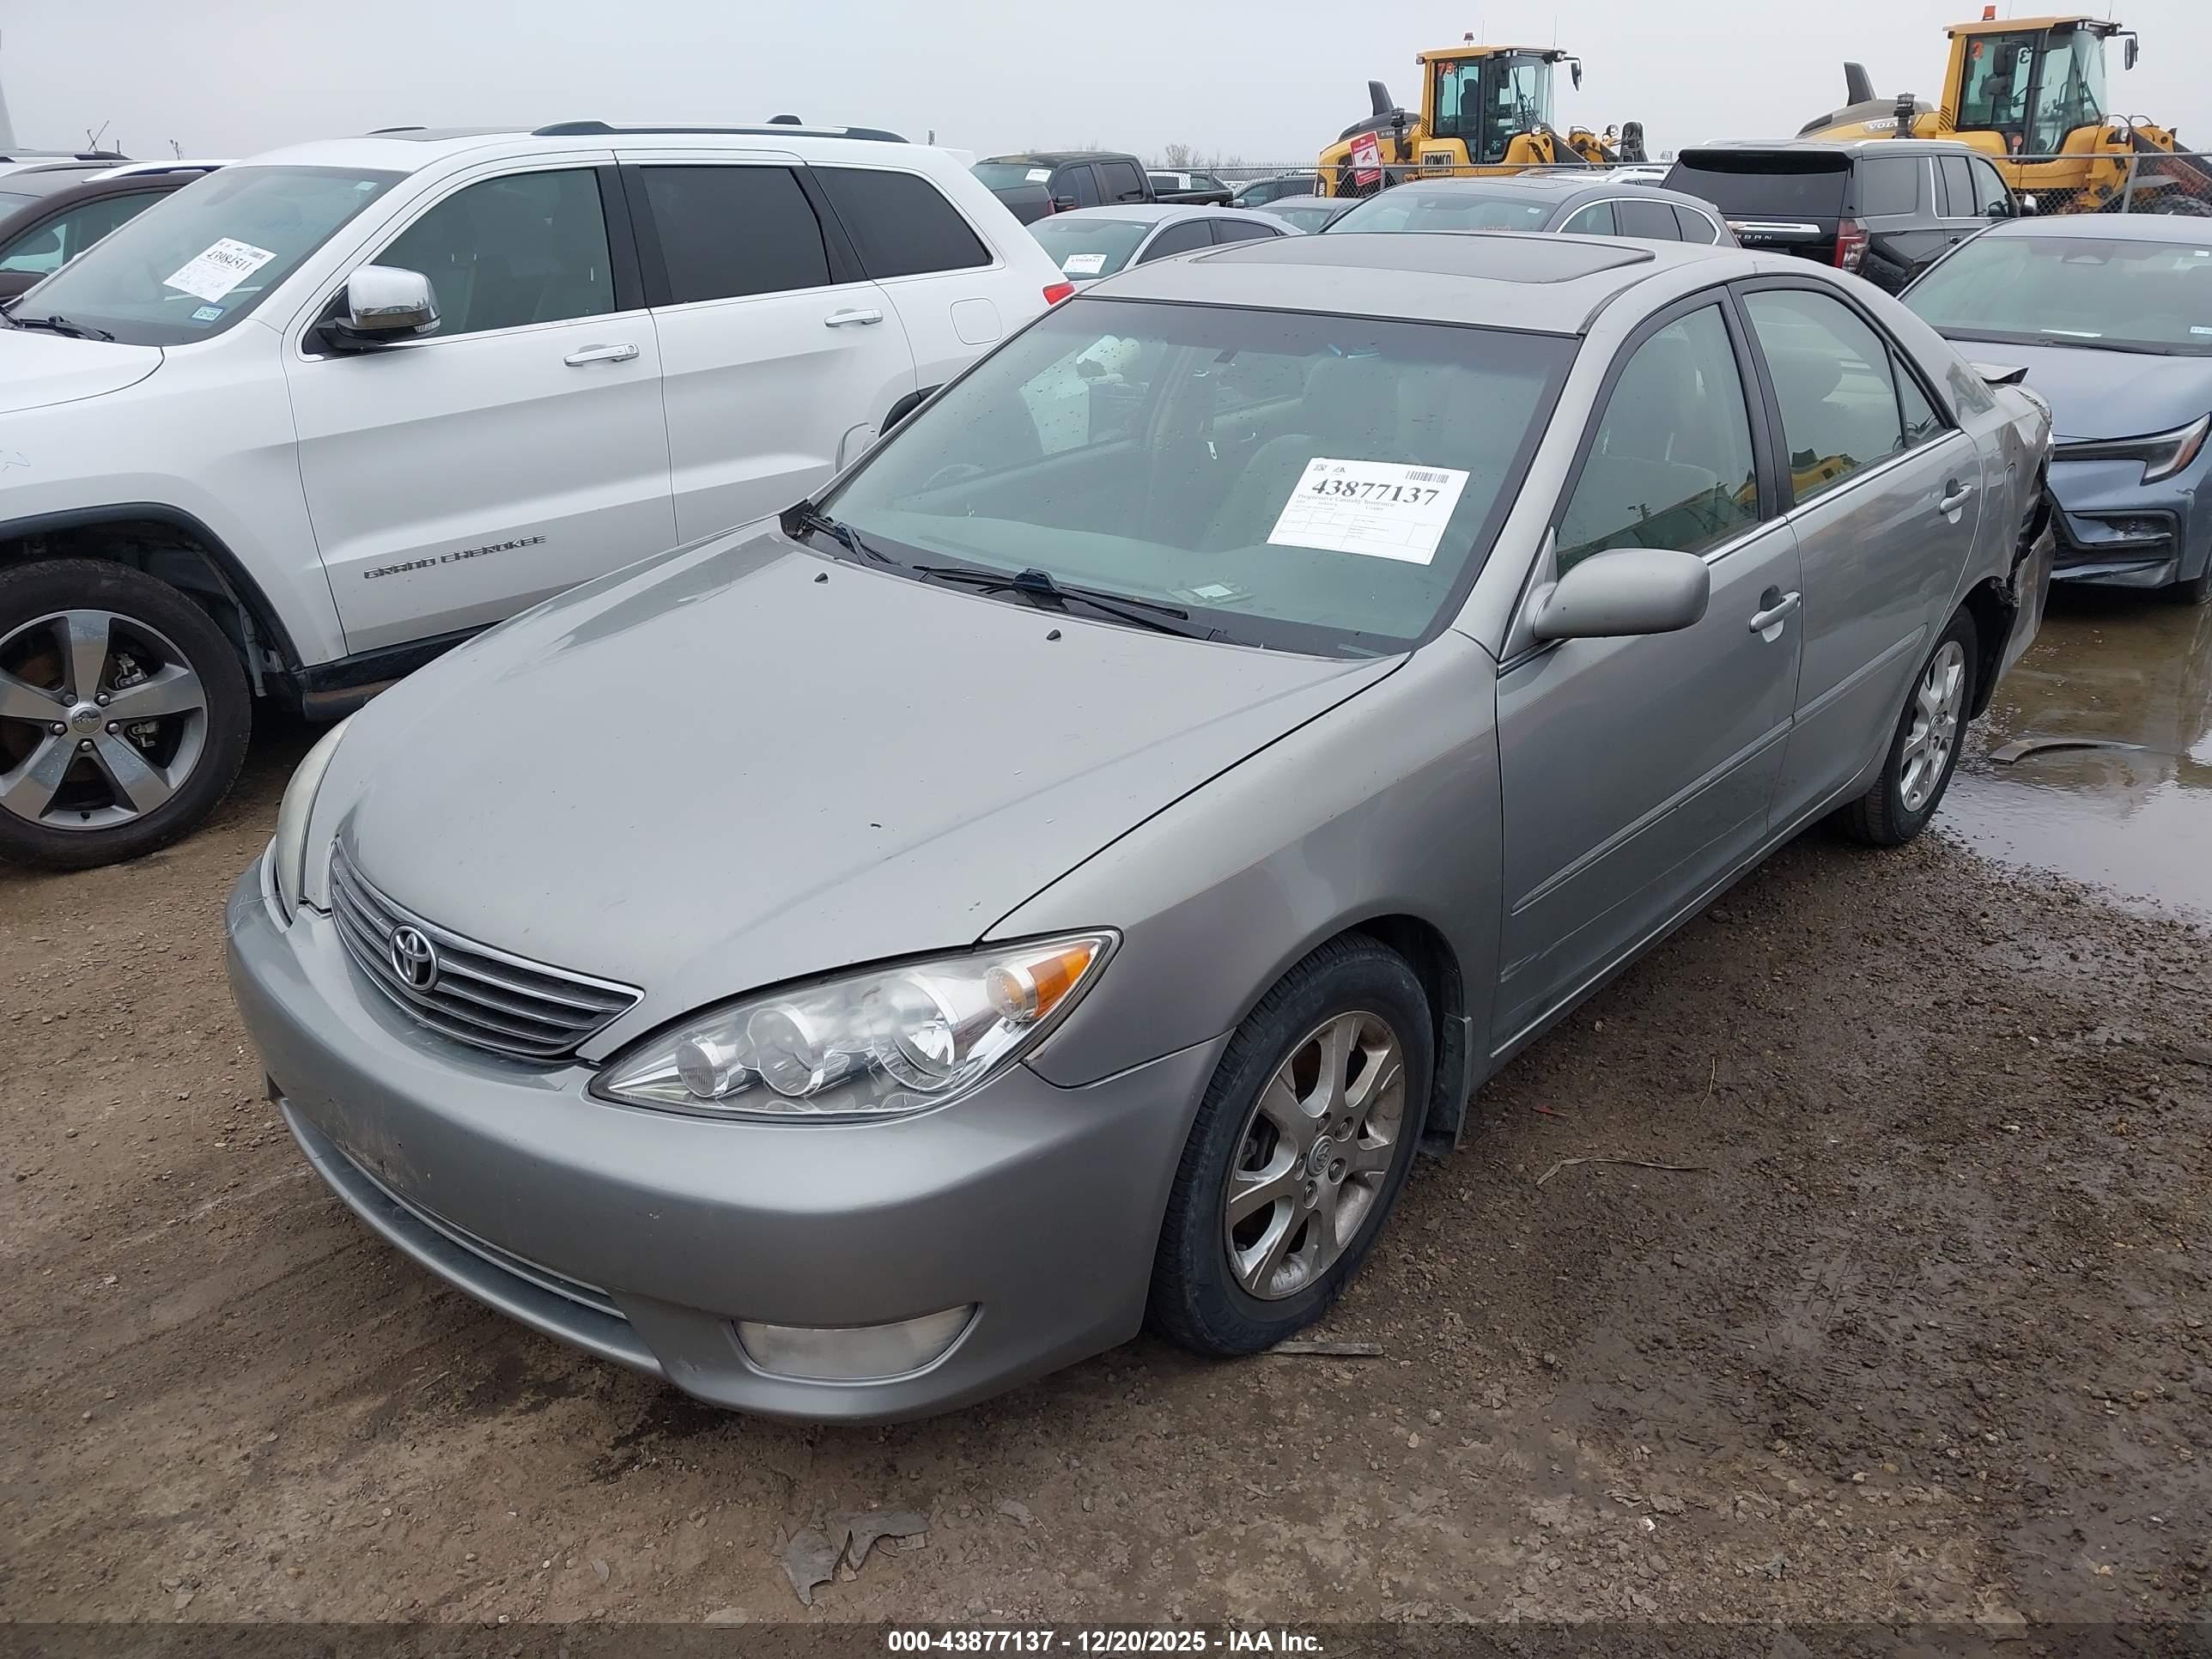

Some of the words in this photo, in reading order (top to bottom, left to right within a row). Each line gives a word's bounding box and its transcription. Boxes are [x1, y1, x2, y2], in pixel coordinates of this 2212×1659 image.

[1425, 154, 1451, 166] ROMCO
[206, 249, 252, 272] 43984511
[1312, 478, 1439, 506] 43877137
[364, 556, 435, 579] GRAND
[441, 534, 547, 562] CHEROKEE
